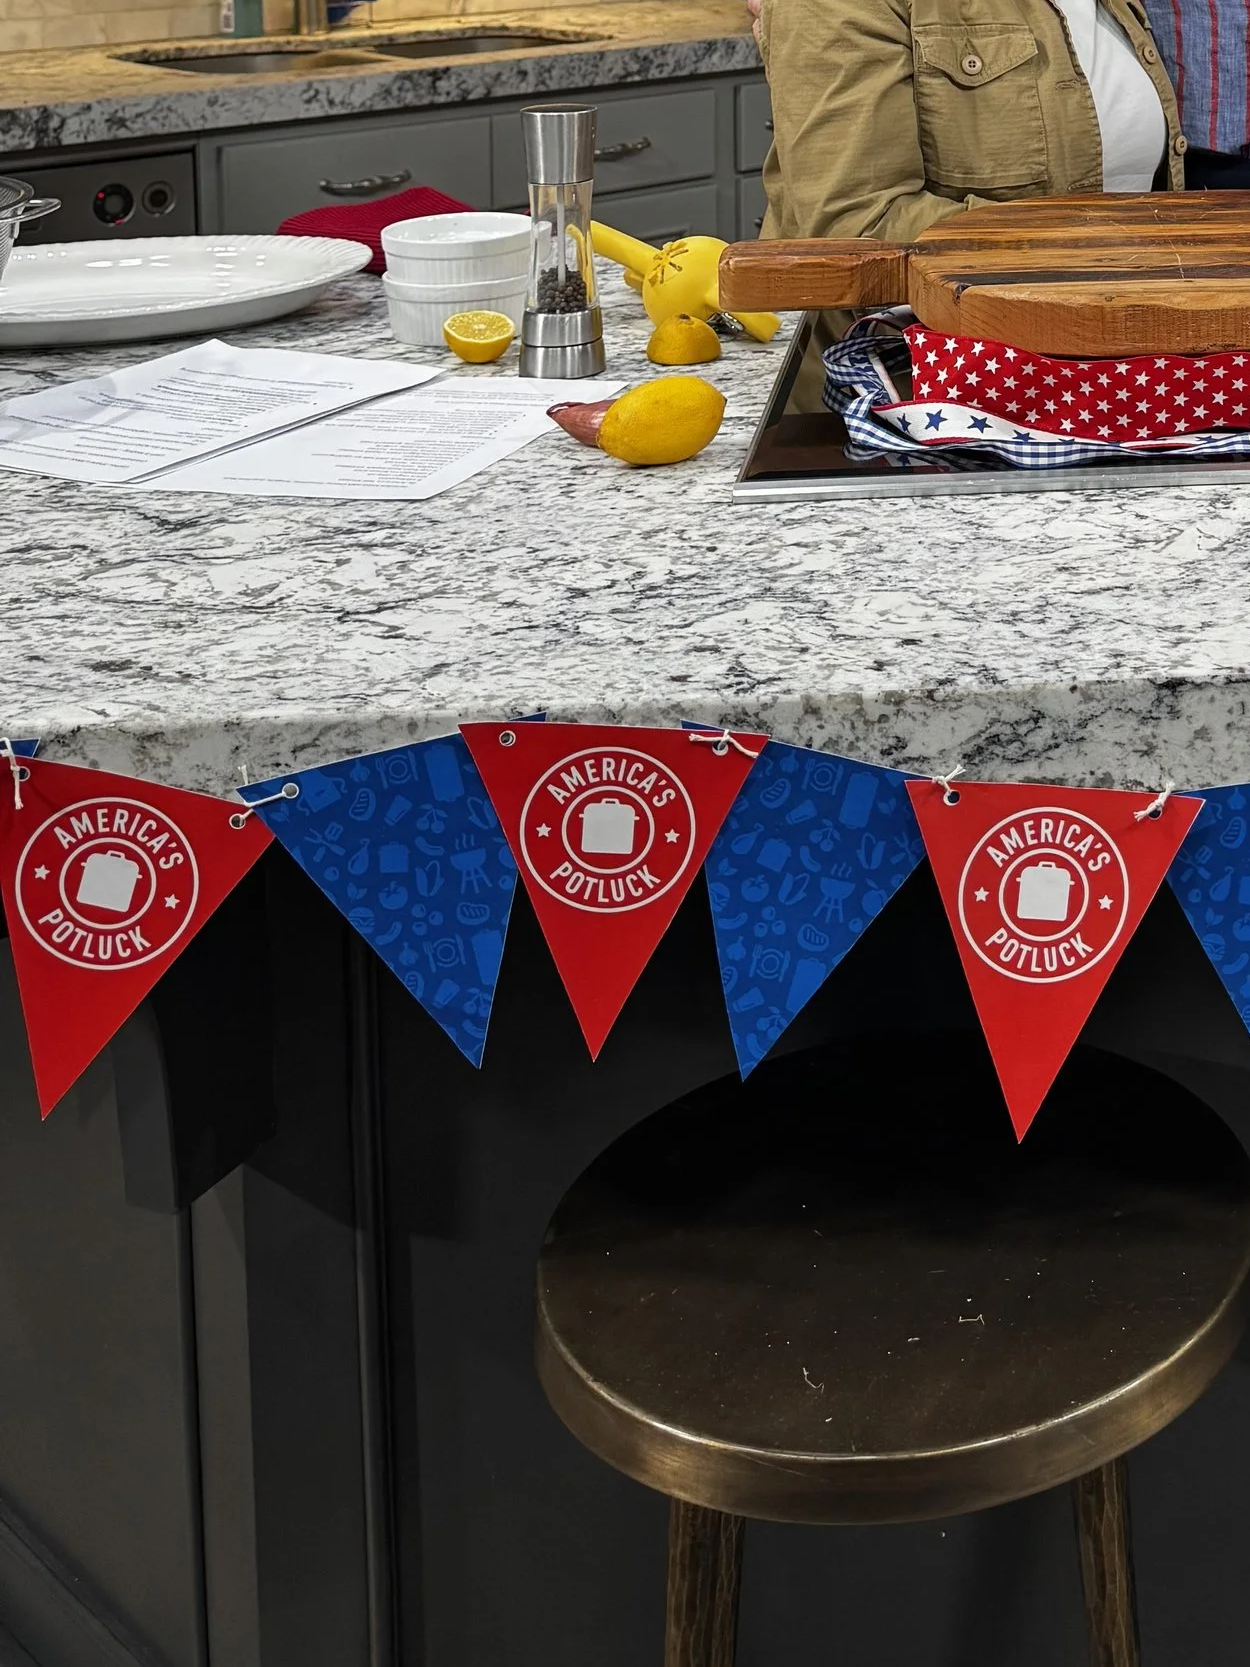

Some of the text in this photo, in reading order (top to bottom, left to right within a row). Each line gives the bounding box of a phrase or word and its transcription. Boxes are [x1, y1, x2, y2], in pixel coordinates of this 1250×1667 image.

[546, 757, 676, 807] AMERICA'S
[53, 808, 184, 870] AMERICA'S
[986, 818, 1111, 872] AMERICA'S
[549, 860, 661, 903] POTLUCK
[38, 908, 152, 960] POTLUCK
[984, 927, 1094, 973] POTLUCK
